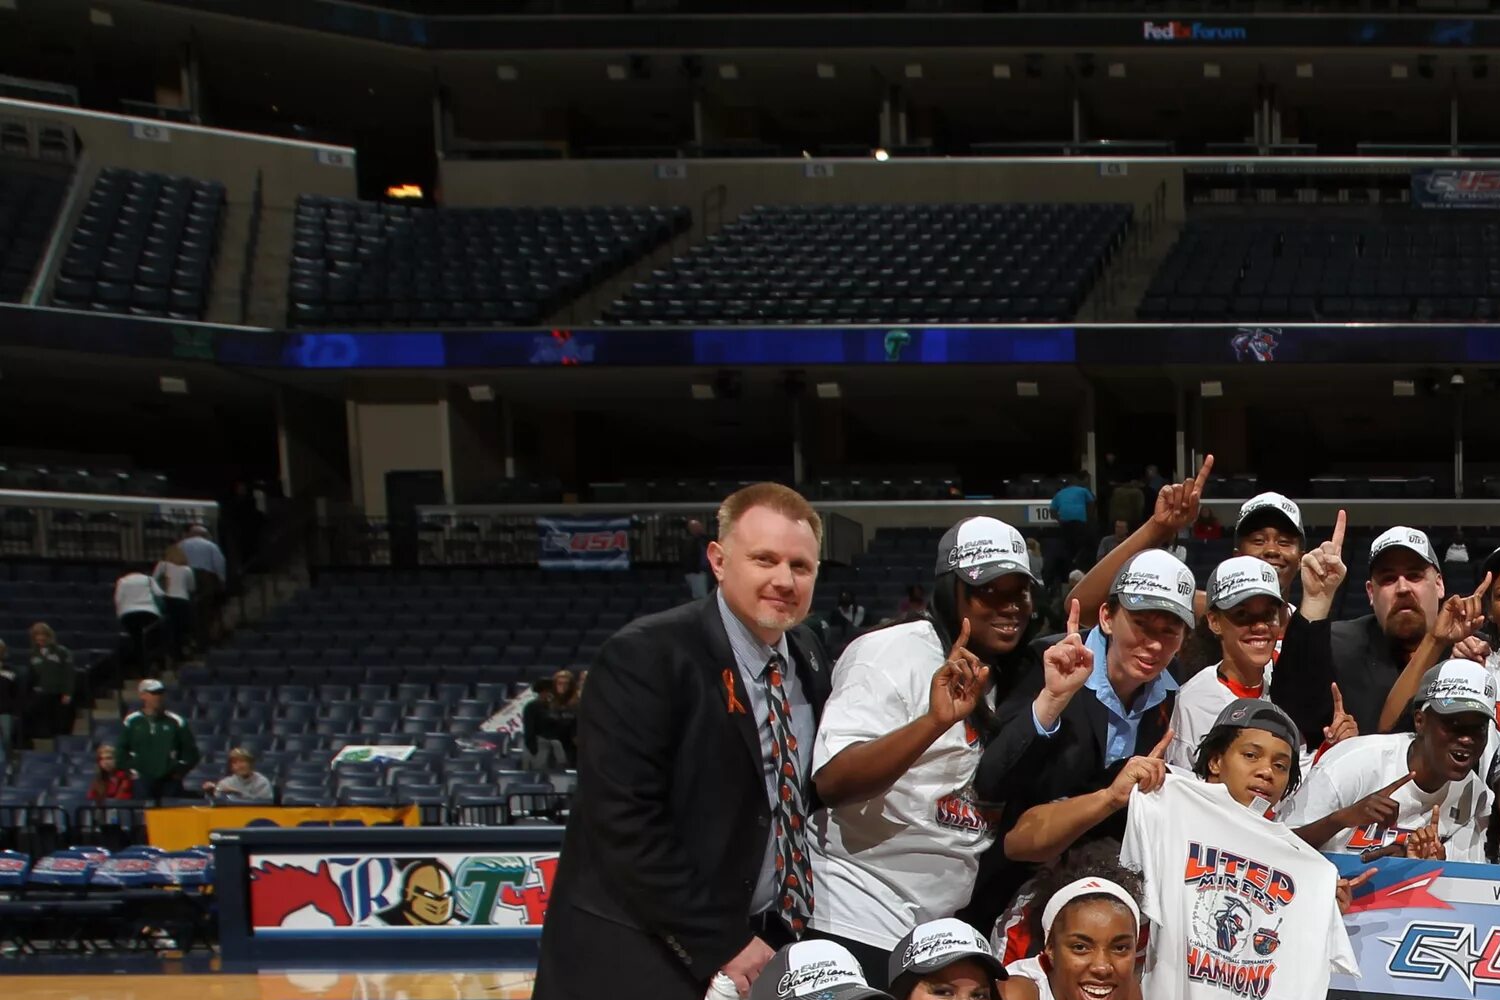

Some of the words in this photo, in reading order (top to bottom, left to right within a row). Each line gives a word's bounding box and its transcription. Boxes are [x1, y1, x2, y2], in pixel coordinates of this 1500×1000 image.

[1143, 21, 1246, 40] FedExForum
[1177, 581, 1192, 596] UTEP
[1184, 840, 1296, 907] UTEP
[1198, 876, 1278, 914] MINERS
[902, 939, 970, 968] Champions
[935, 944, 952, 952] 2012
[777, 968, 856, 998] Champions
[819, 977, 838, 985] 2012
